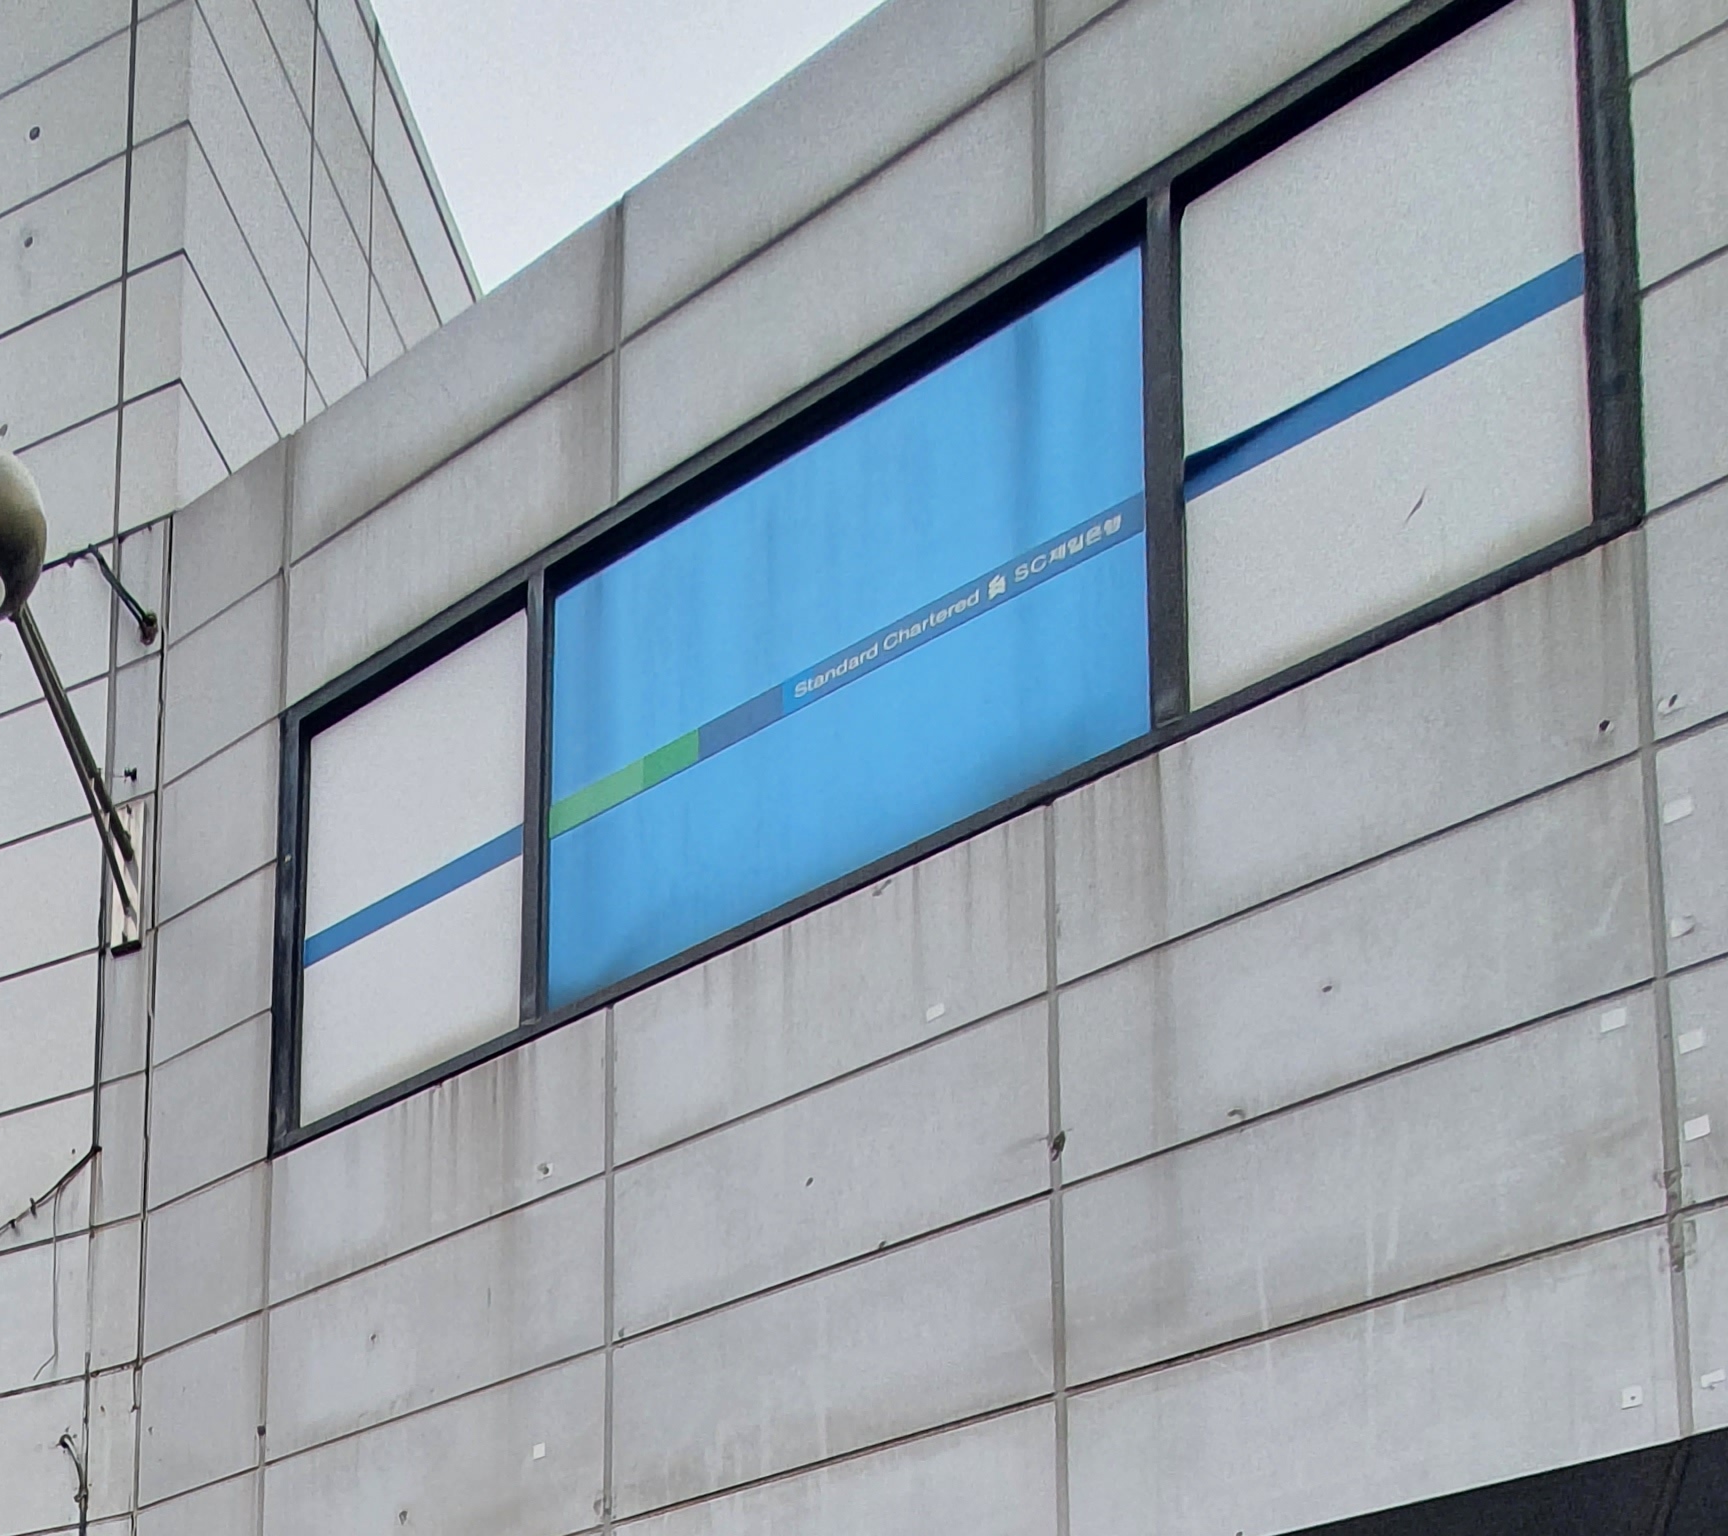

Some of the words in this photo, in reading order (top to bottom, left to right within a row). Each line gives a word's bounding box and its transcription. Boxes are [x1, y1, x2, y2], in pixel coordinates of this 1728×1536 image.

[794, 643, 878, 699] Standard
[883, 589, 979, 651] Chartered
[1014, 514, 1122, 583] SC제일은행
